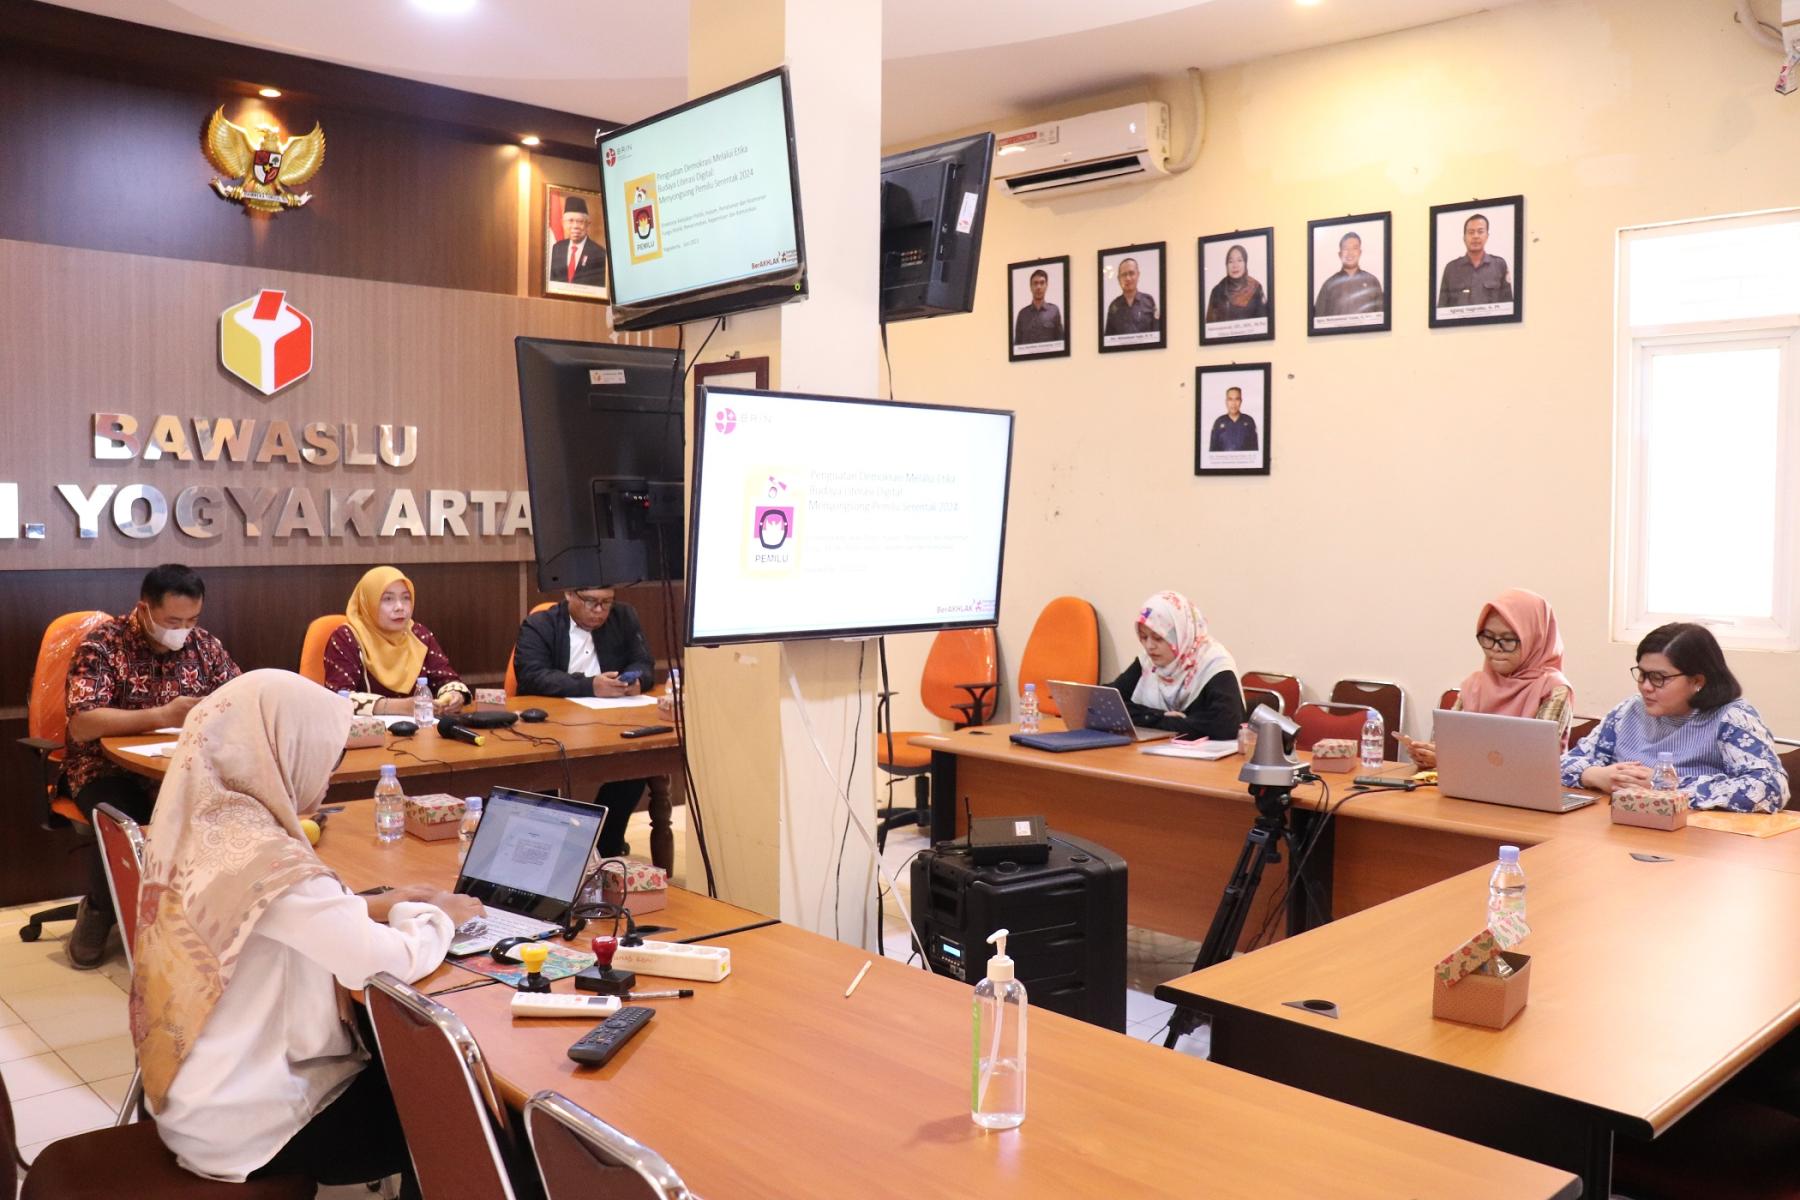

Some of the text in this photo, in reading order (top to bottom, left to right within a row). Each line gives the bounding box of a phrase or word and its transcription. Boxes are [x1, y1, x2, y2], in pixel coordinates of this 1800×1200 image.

[656, 145, 749, 181] Penguatan Demokrasi Melalui Etika
[657, 168, 714, 193] Budaya Literasi Digital
[695, 182, 714, 194] Pemilu
[739, 168, 755, 180] 2024
[636, 241, 655, 251] PEMILU
[751, 257, 780, 270] BerAKHLAK
[92, 412, 419, 467] BAWASLU
[876, 487, 904, 498] Digital
[56, 483, 533, 539] YOGYAKARTA
[754, 553, 790, 564] PEMILU
